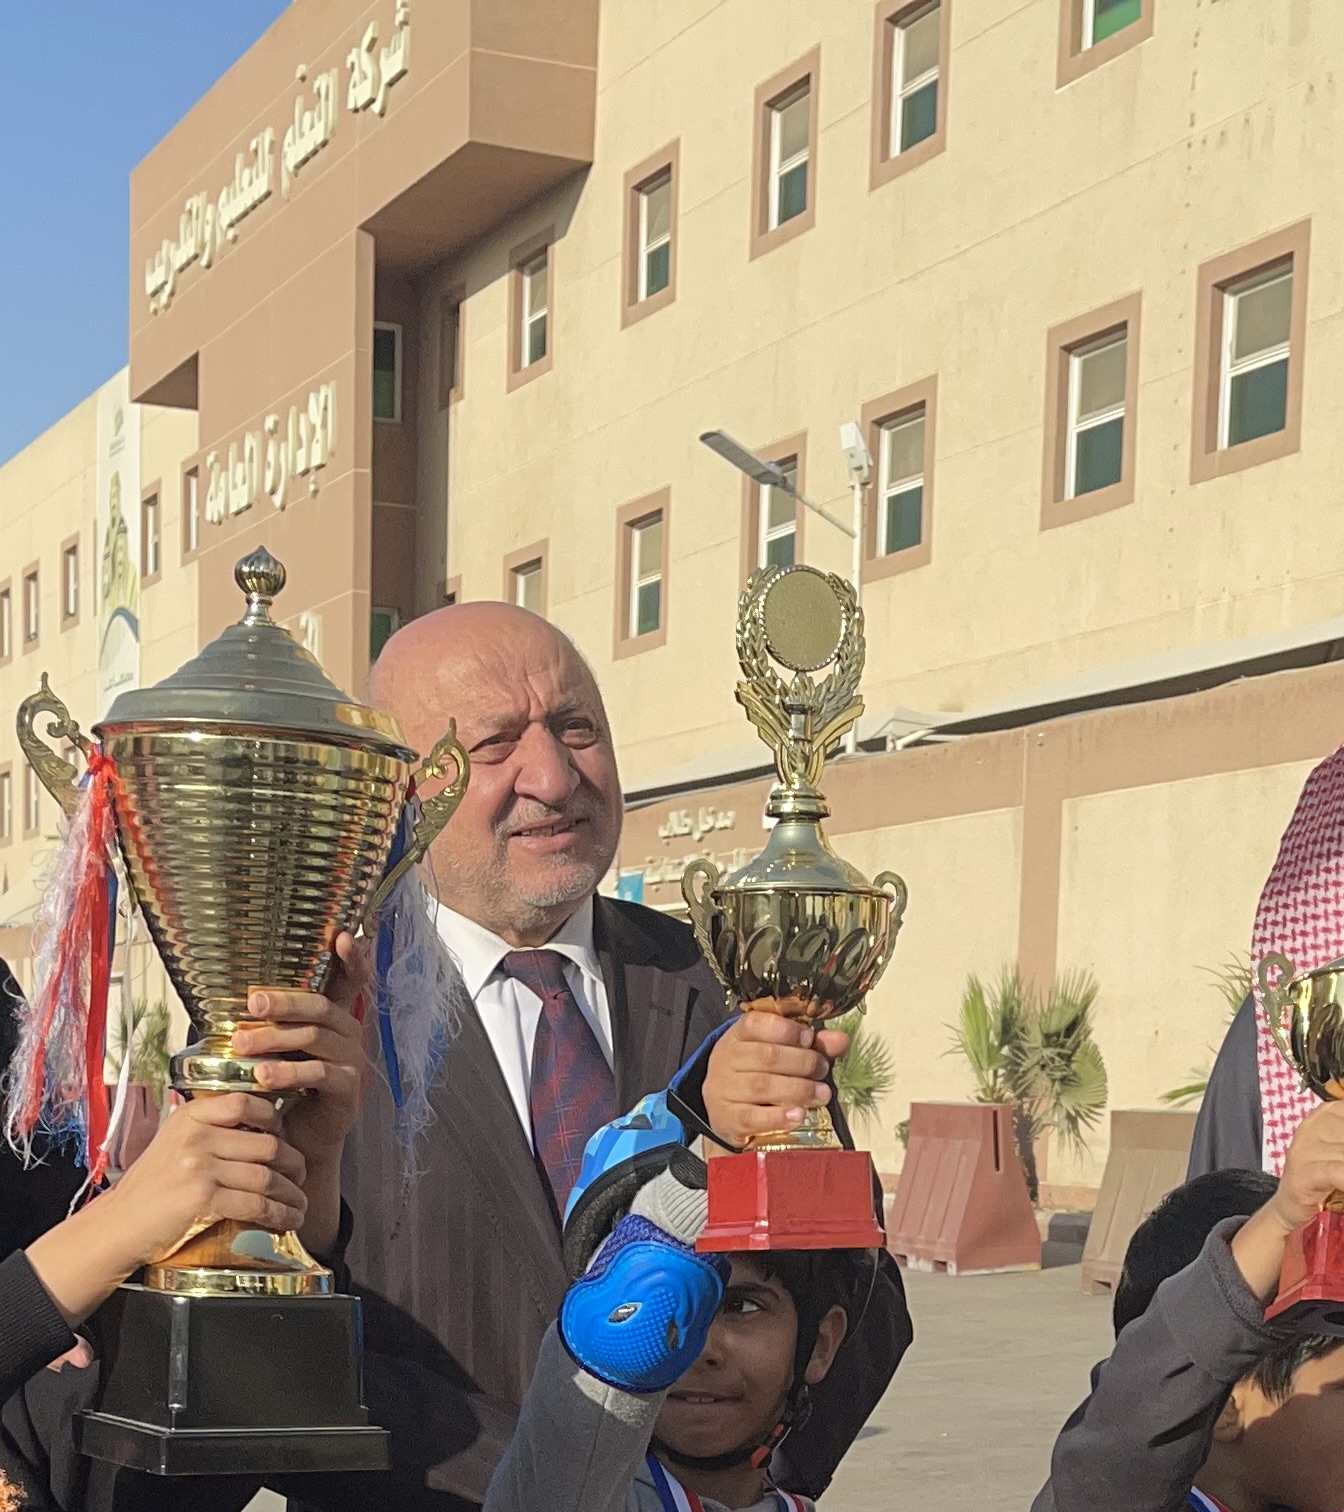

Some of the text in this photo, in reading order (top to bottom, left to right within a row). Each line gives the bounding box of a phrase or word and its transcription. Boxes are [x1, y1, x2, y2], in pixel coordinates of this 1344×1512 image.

[346, 0, 410, 118] شركة
[205, 430, 262, 526] العامة
[693, 806, 736, 842] مدخل
